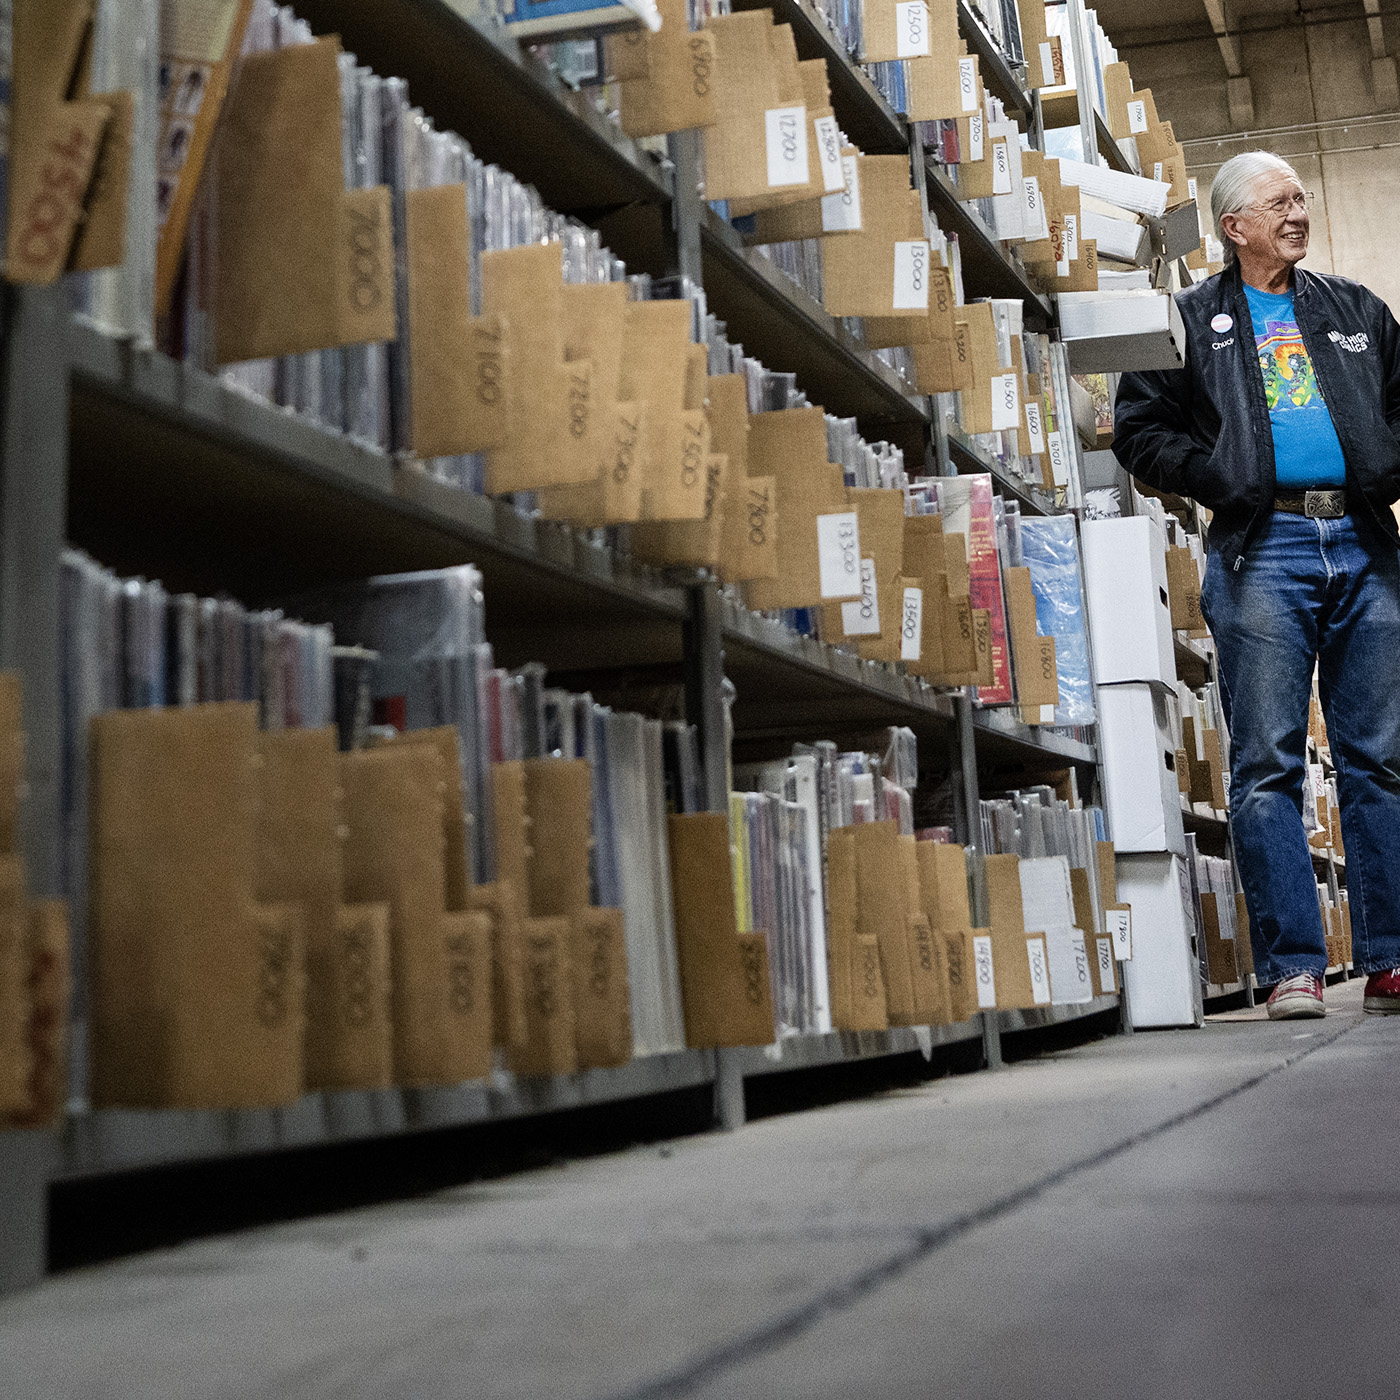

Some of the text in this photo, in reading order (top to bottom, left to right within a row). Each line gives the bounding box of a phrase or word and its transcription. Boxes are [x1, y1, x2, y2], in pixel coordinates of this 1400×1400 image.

[907, 4, 922, 45] 12500
[687, 37, 711, 97] 6900
[958, 61, 973, 94] 12600
[778, 114, 798, 162] 12700
[817, 121, 838, 164] 12800
[970, 112, 981, 143] 5700
[994, 146, 1007, 173] 15800
[1023, 181, 1037, 210] 15900
[343, 204, 381, 311] 7000
[910, 245, 926, 291] 13000
[1084, 244, 1094, 270] 16400
[933, 273, 949, 313] 13100
[474, 320, 504, 406] 7100
[955, 327, 967, 363] 13200
[568, 369, 590, 439] 7200
[1003, 377, 1014, 410] 16500
[1027, 406, 1039, 436] 16600
[611, 414, 639, 485] 7300
[678, 421, 705, 490] 7500
[1049, 440, 1063, 466] 16700
[748, 485, 770, 546] 7800
[839, 521, 857, 575] 13300
[902, 595, 920, 639] 13500
[974, 612, 989, 654] 13800
[1038, 642, 1054, 681] 16800
[1313, 768, 1325, 797] 24500
[1118, 914, 1129, 944] 17800
[976, 940, 993, 986] 14800
[1028, 944, 1044, 984] 17000
[1070, 938, 1088, 983] 17200
[1099, 942, 1112, 970] 17700
